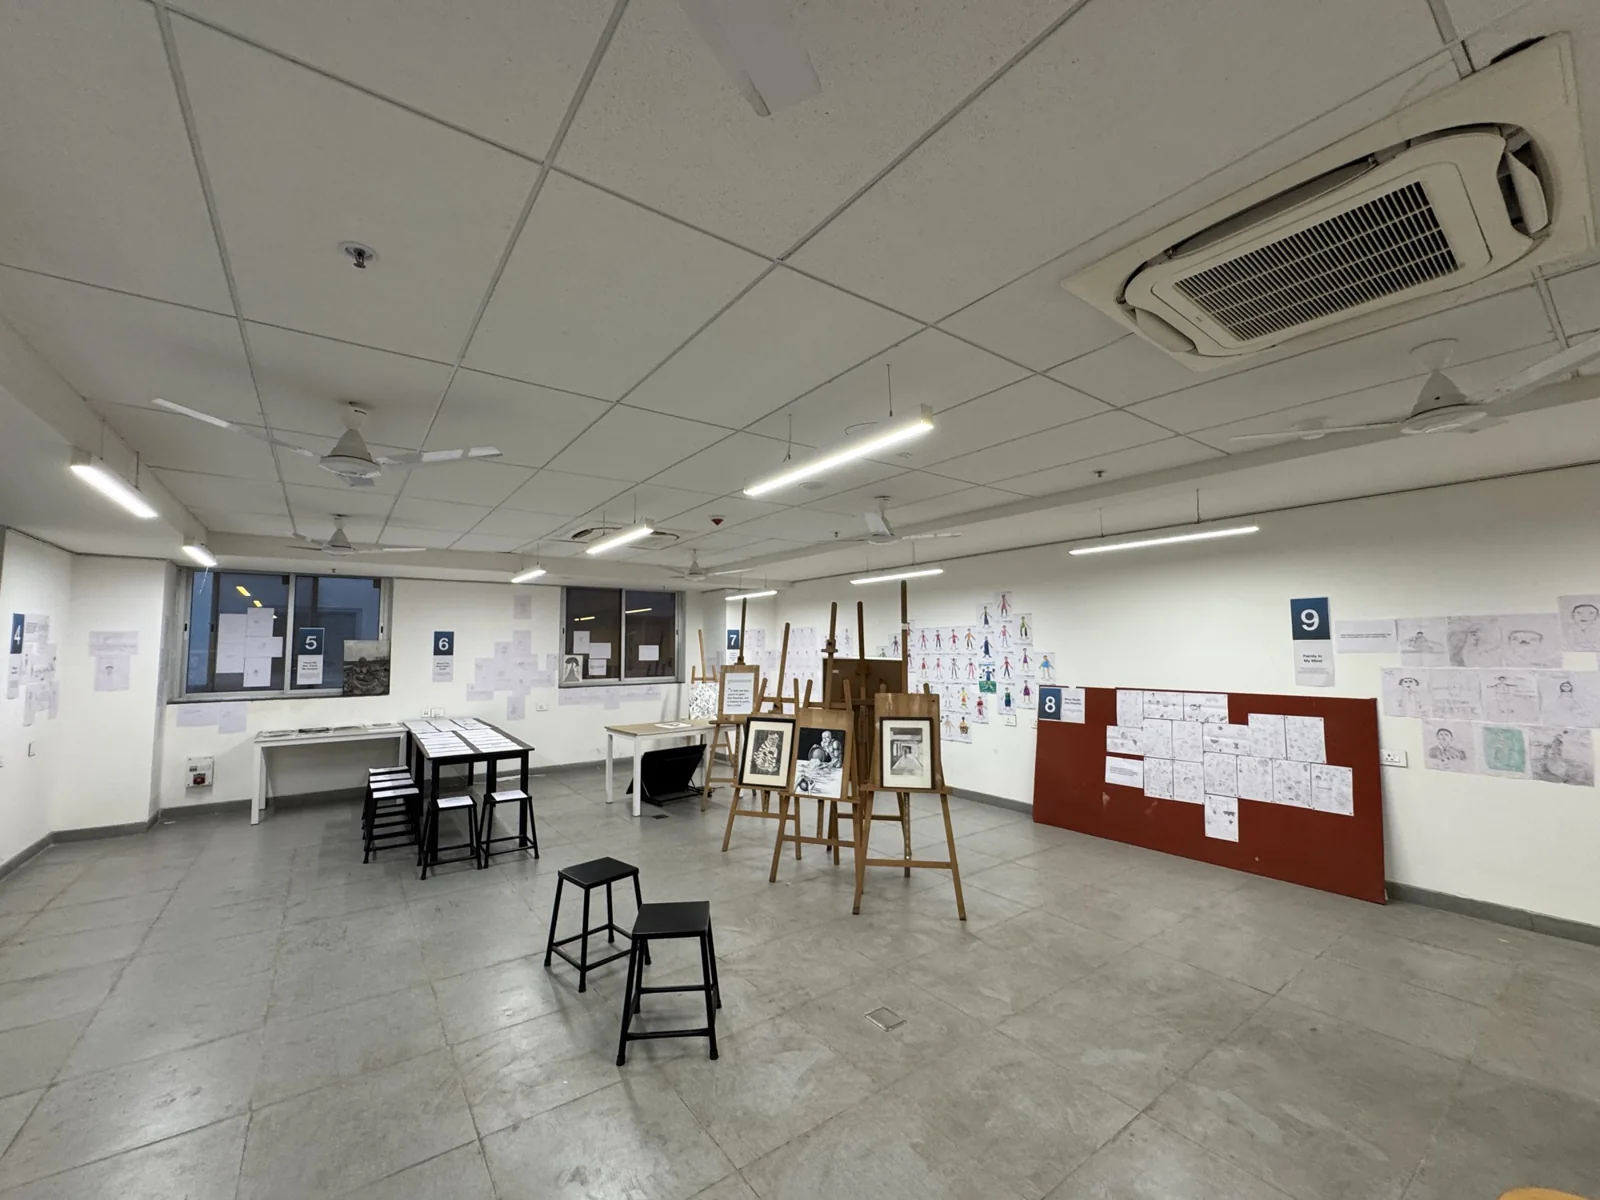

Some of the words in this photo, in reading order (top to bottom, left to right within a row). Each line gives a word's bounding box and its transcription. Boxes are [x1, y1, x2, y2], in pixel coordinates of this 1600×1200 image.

[1300, 608, 1320, 631] 9
[14, 625, 21, 645] 4
[305, 635, 318, 650] 5
[729, 634, 737, 646] 7
[438, 637, 449, 651] 6
[1044, 695, 1056, 713] 8
